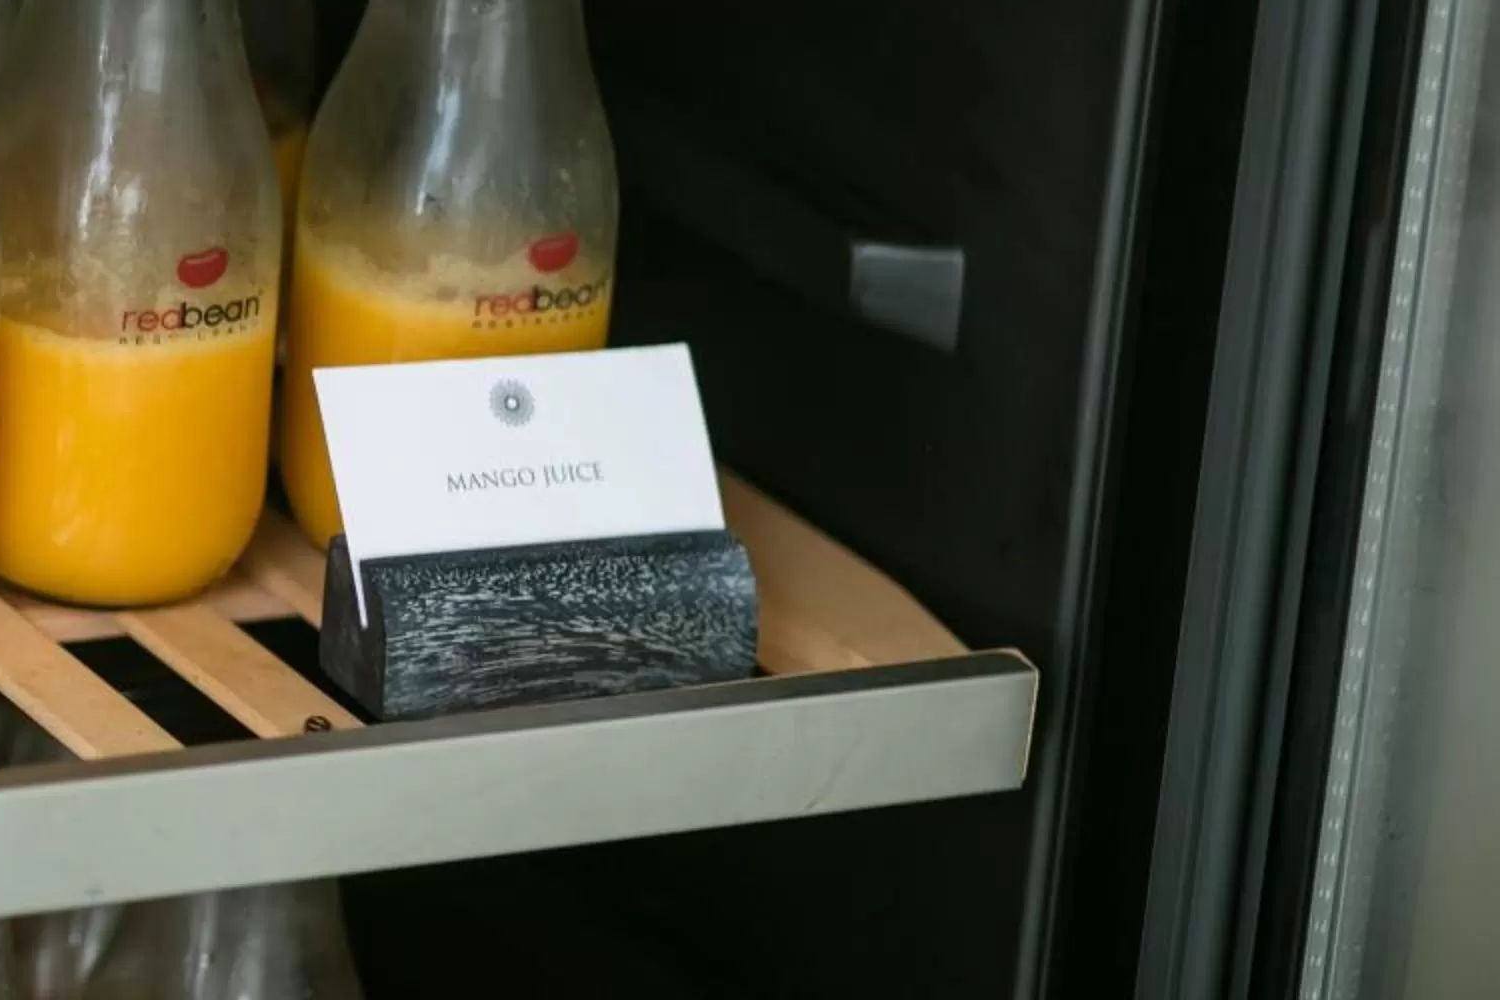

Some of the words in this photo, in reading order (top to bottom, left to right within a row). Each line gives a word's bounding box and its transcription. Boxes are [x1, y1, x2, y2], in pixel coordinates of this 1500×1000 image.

[122, 295, 261, 332] redbean
[447, 468, 536, 493] MANGO
[543, 461, 605, 488] JUICE
